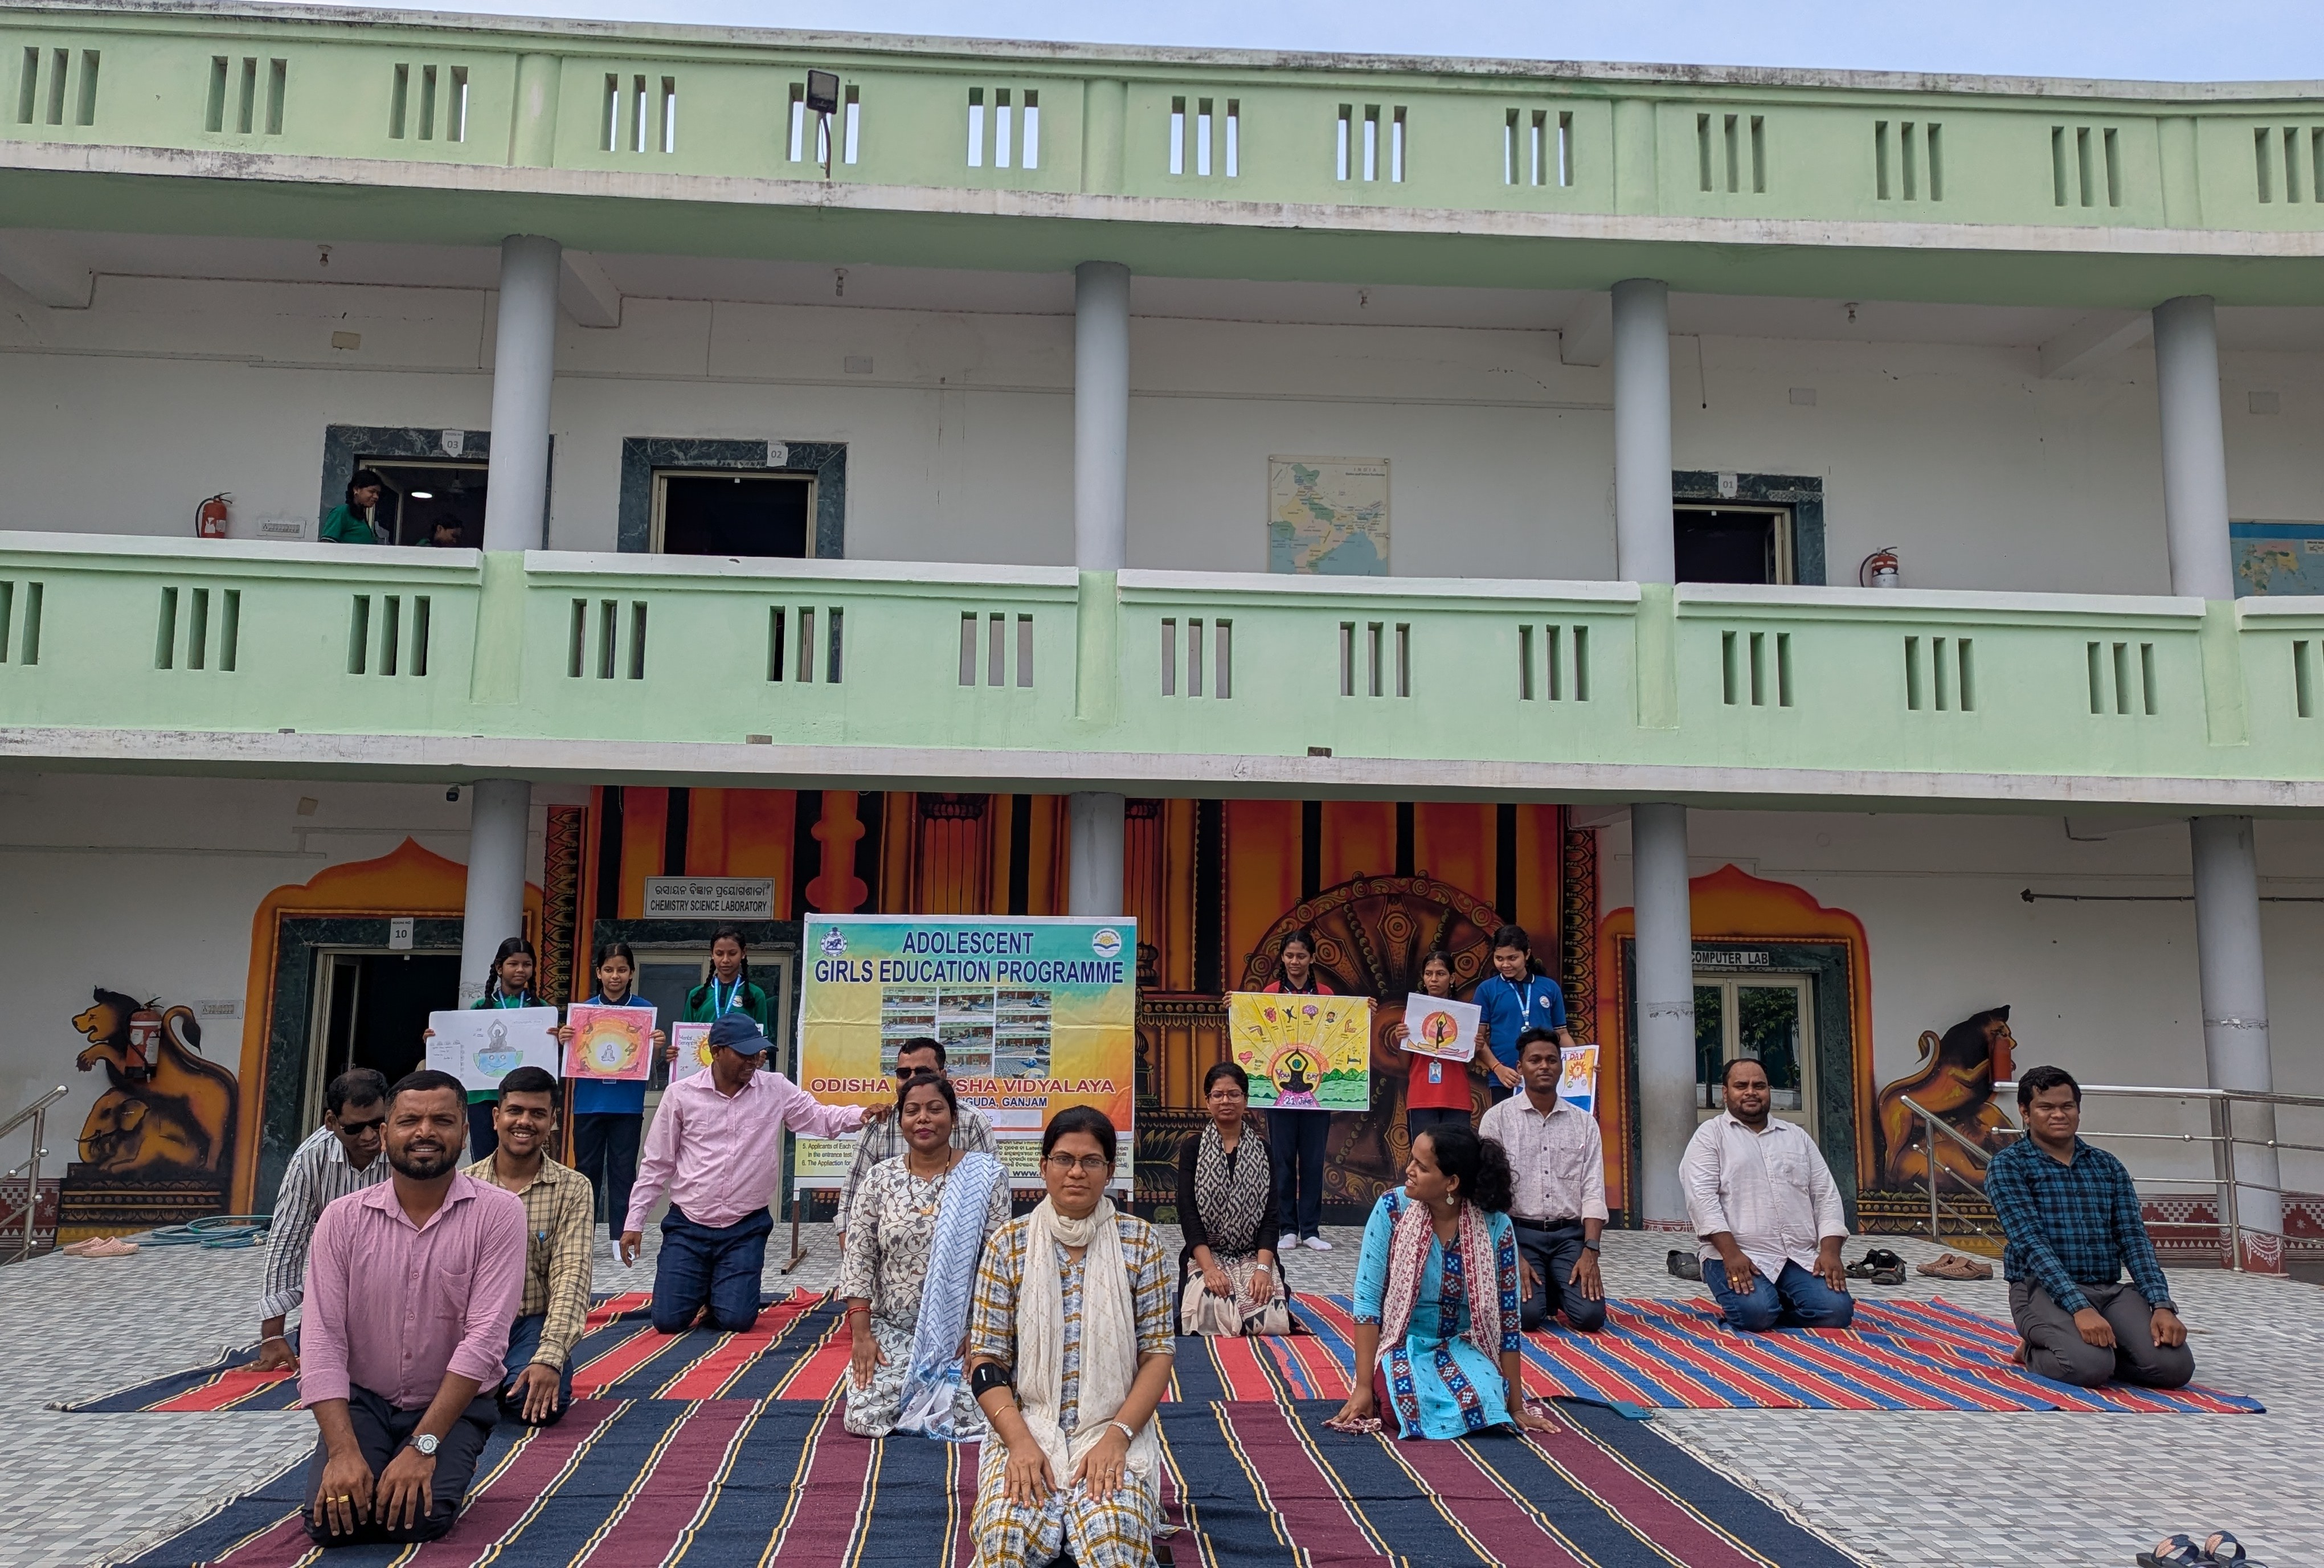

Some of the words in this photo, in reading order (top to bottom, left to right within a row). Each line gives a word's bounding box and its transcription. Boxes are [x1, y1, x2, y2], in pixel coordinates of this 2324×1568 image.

[655, 886, 686, 895] ରସାୟନ
[650, 900, 689, 911] CHEMISTRY
[690, 900, 719, 911] SCIENCE
[721, 900, 767, 912] LABORATORY
[395, 930, 407, 938] 10
[902, 932, 1034, 954] ADOLESCENT
[1748, 953, 1768, 964] LAB
[815, 960, 873, 982] GIRLS
[879, 960, 991, 982] EDUCATION
[997, 961, 1124, 983] PROGRAMME
[811, 1079, 890, 1092] ODISHA
[1003, 1080, 1115, 1093] VIDYALAYA
[1003, 1097, 1048, 1107] GANJAM
[1285, 1096, 1295, 1105] 21
